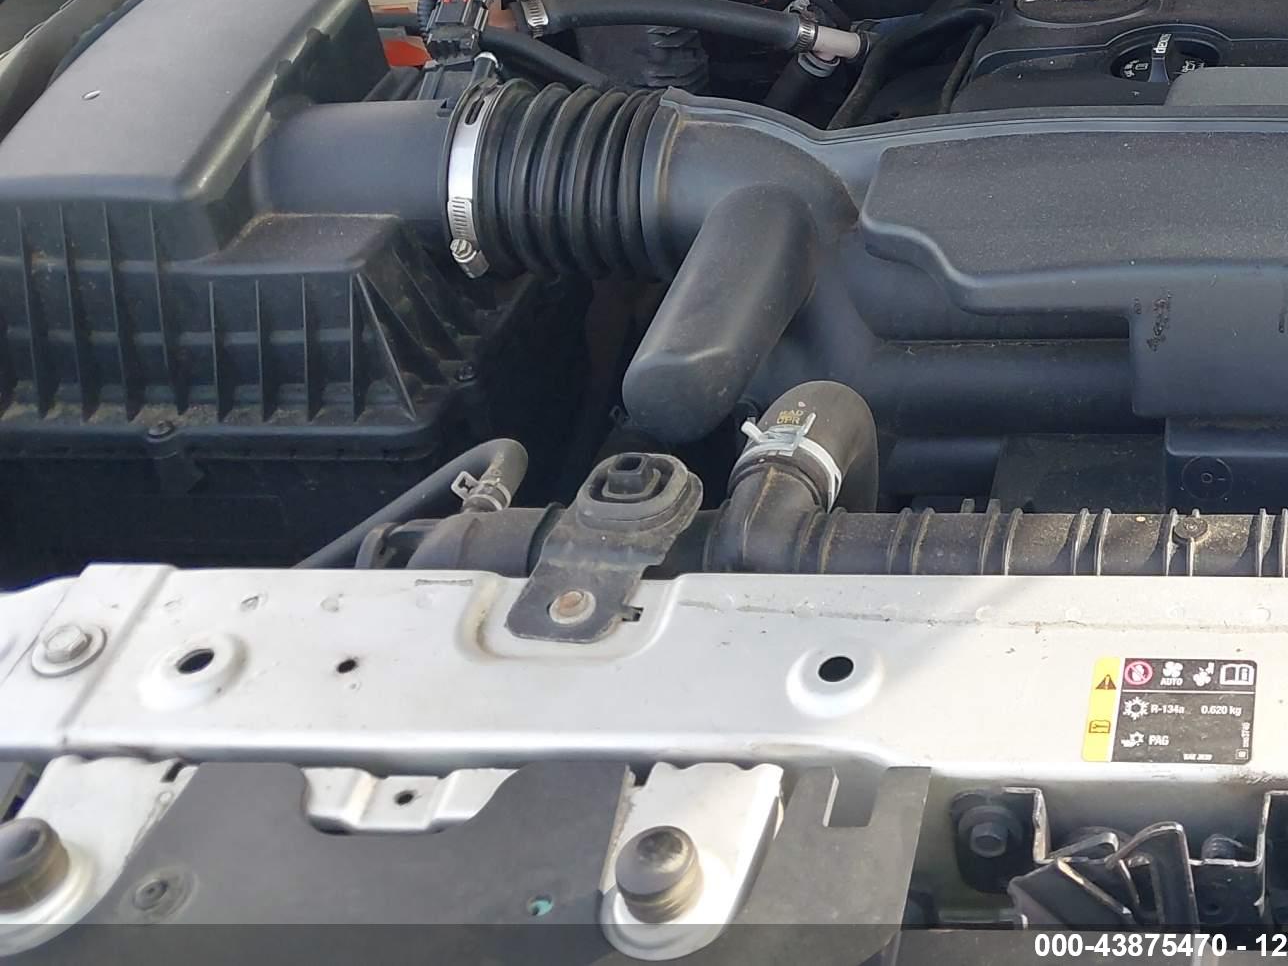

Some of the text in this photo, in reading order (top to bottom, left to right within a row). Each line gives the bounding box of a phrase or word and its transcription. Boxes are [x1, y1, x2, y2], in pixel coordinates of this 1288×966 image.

[1160, 677, 1184, 687] AUTO
[1150, 704, 1185, 715] R-134a
[1229, 705, 1242, 717] kg
[1148, 735, 1170, 746] PAG
